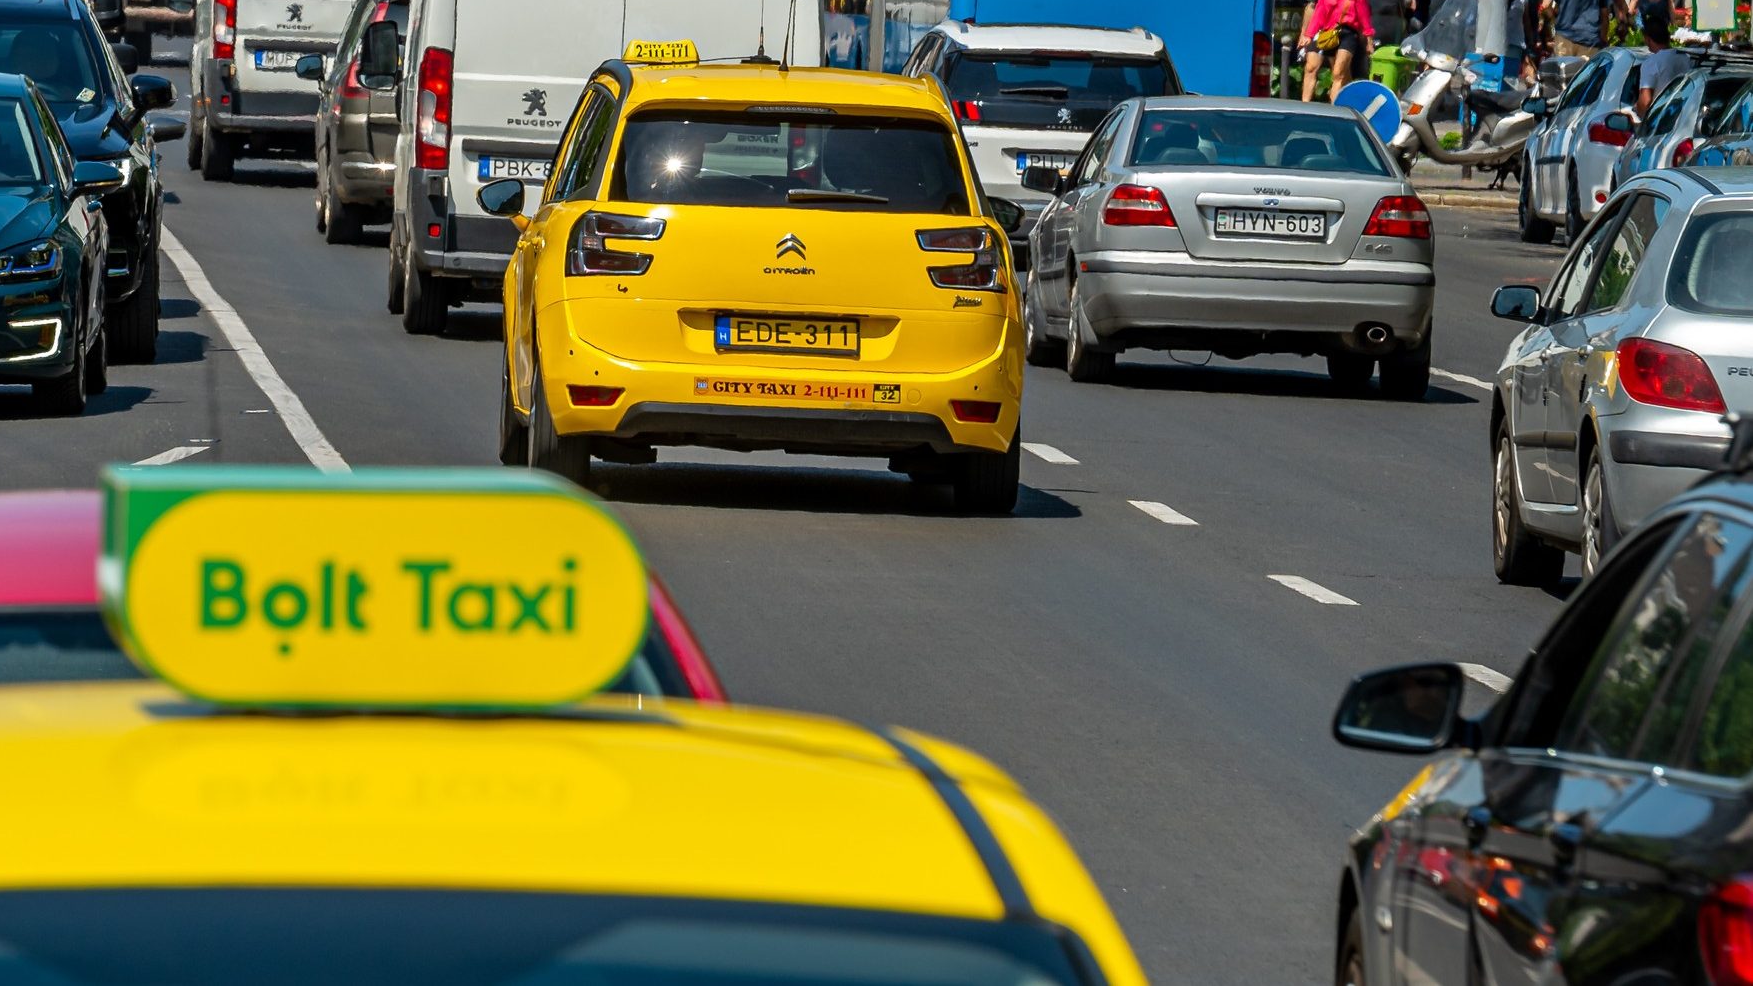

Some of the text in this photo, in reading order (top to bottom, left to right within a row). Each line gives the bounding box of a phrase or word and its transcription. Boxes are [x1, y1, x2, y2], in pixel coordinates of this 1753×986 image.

[507, 118, 562, 127] PEUGEOT
[1233, 210, 1322, 233] HYN-603
[737, 320, 849, 346] EDE-311
[713, 381, 754, 393] CITY
[757, 382, 796, 395] TAXI
[804, 385, 867, 399] 2-111-111
[880, 390, 895, 401] 32
[399, 557, 578, 632] Taxi
